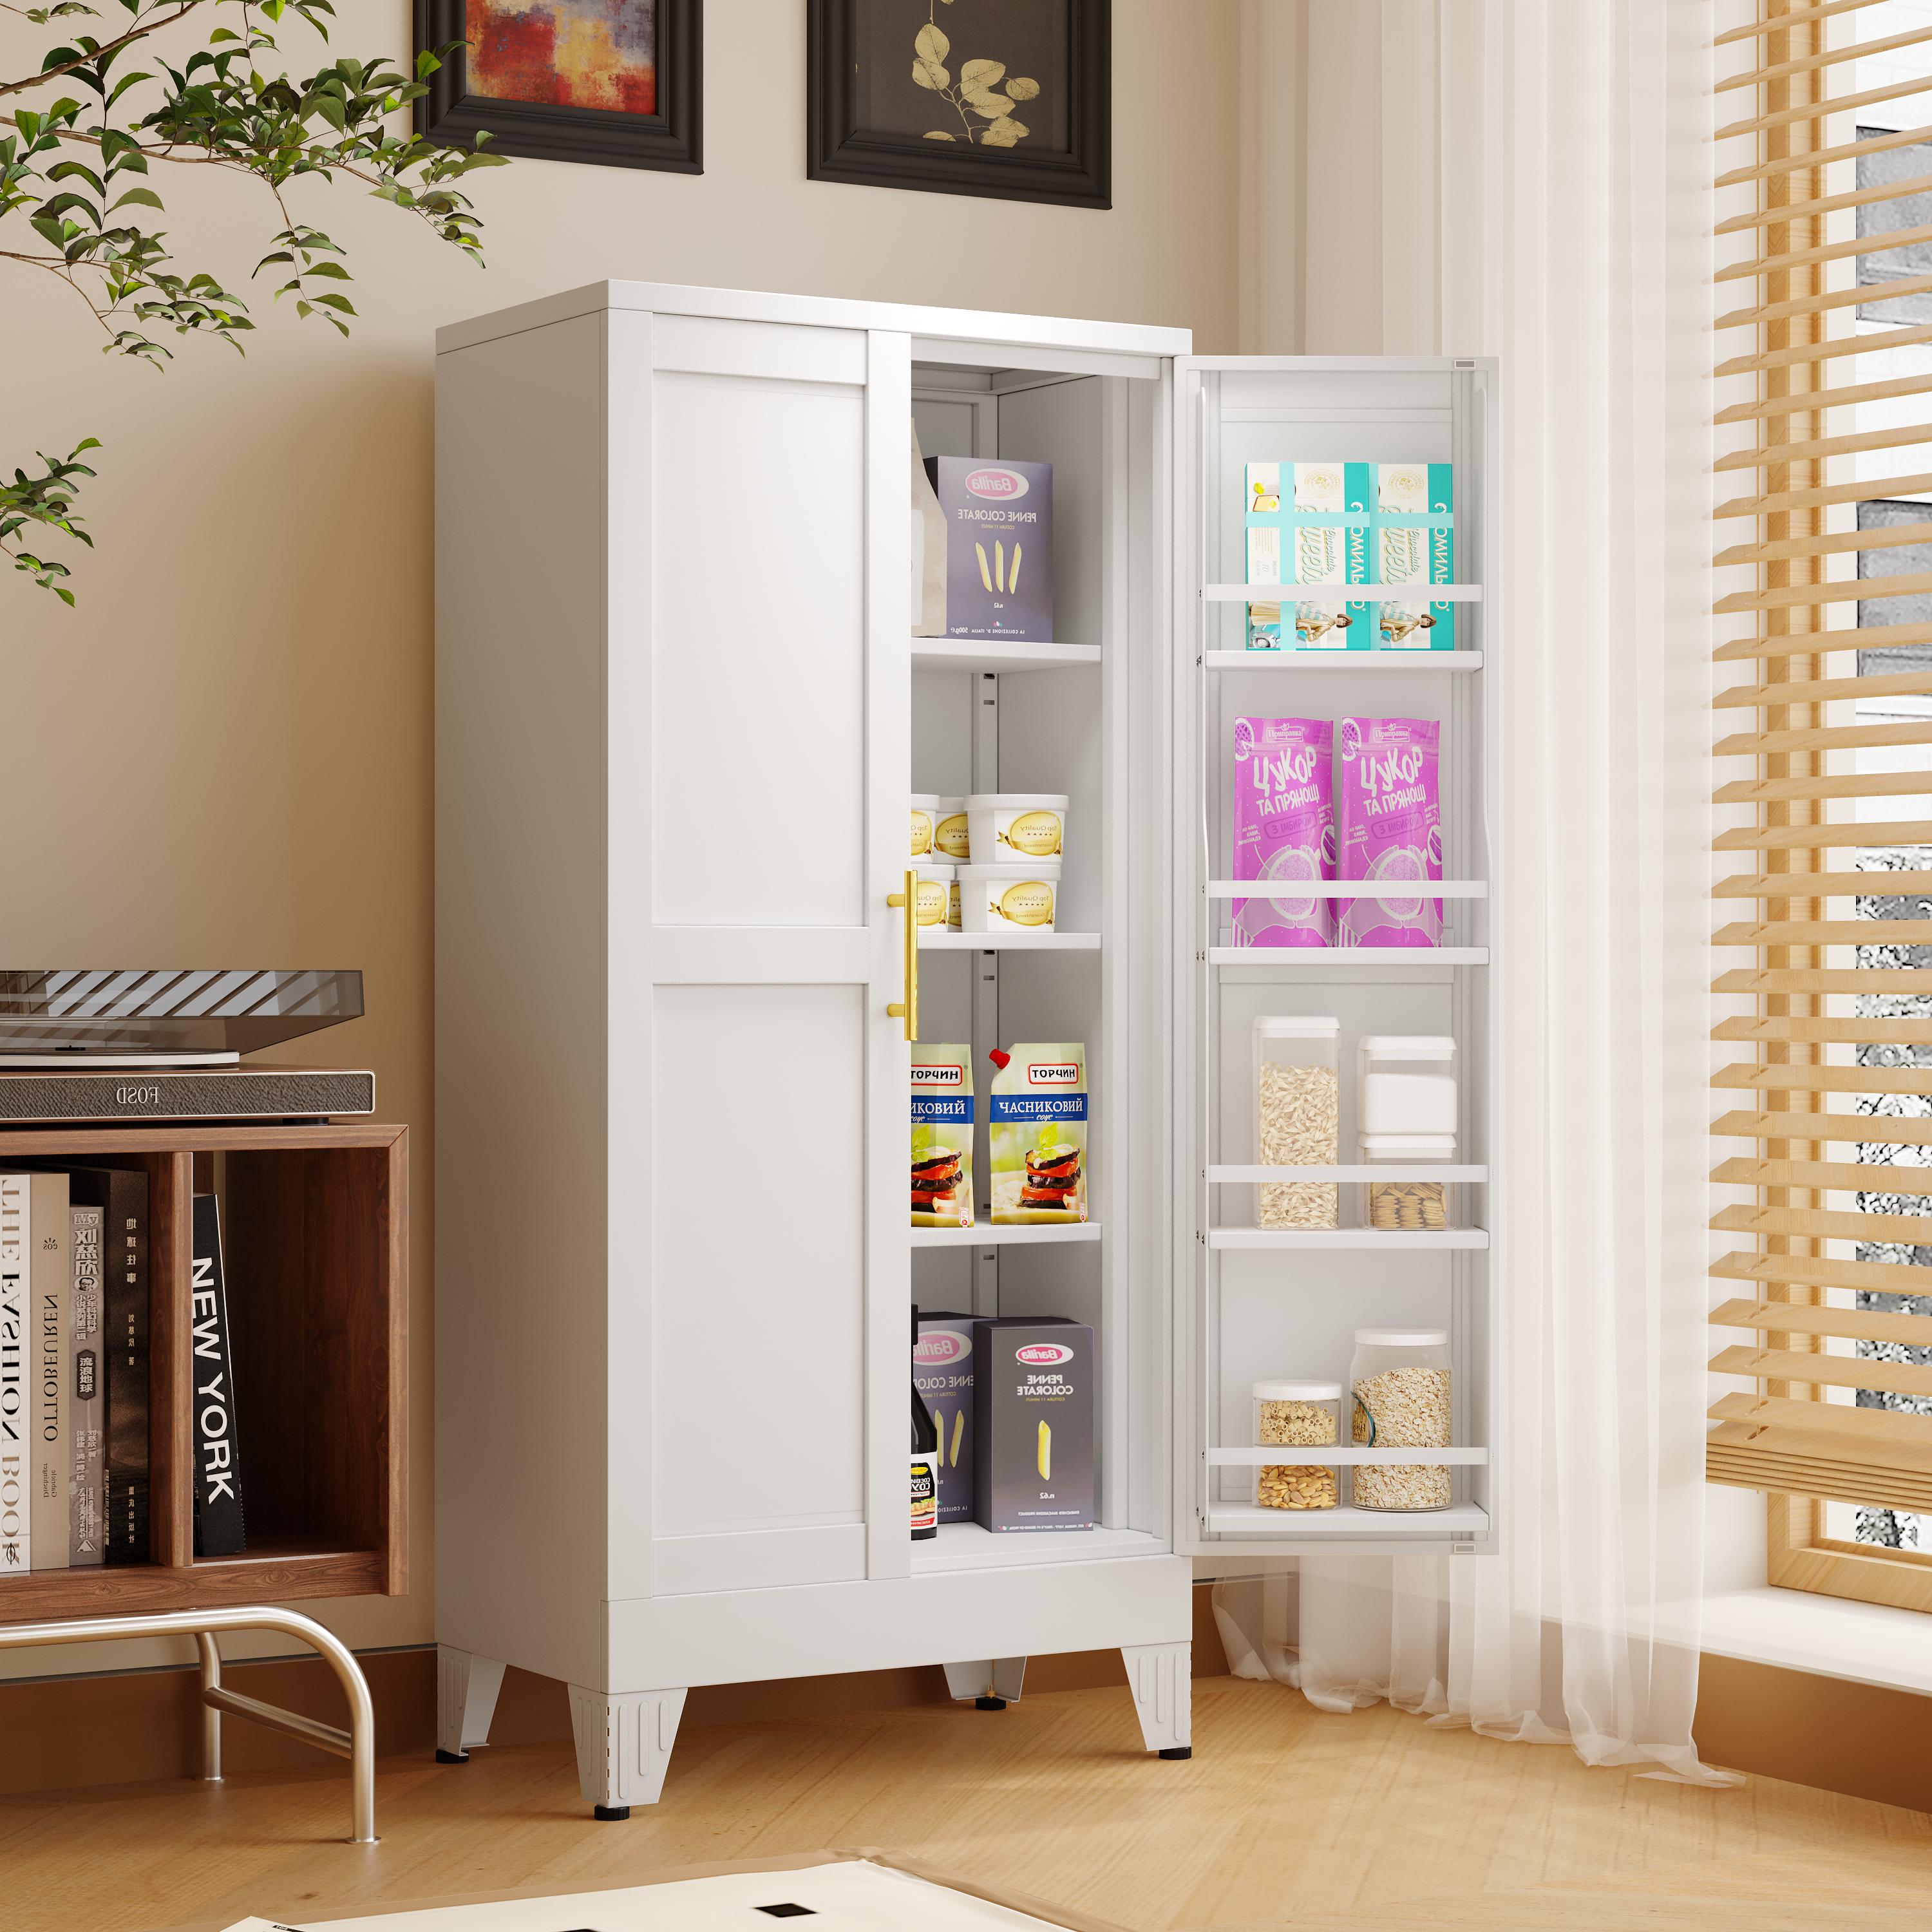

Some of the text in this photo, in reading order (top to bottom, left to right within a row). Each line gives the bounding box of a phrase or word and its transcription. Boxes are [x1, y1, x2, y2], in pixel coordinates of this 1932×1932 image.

[1350, 502, 1365, 610] ОМИЛЬО
[1434, 502, 1448, 611] ОМИЛЬО
[1268, 729, 1302, 741] Приправка
[1376, 729, 1409, 741] Приправка
[1254, 746, 1317, 797] ЦУКОР
[1361, 746, 1424, 797] ЦУКОР
[1256, 799, 1275, 817] ТА
[1276, 784, 1320, 813] ПРЯНОЩІ
[1363, 799, 1383, 817] ТА
[1384, 784, 1426, 813] ПРЯНОЩІ
[1032, 1069, 1075, 1079] ТОРЧИН
[999, 1098, 1083, 1114] ЧАСНИКОВИЙ
[1036, 1113, 1054, 1122] соус
[74, 1228, 99, 1276] 刘慈欣
[79, 1357, 93, 1393] 流浪地球
[193, 1256, 234, 1505] NEW YORK
